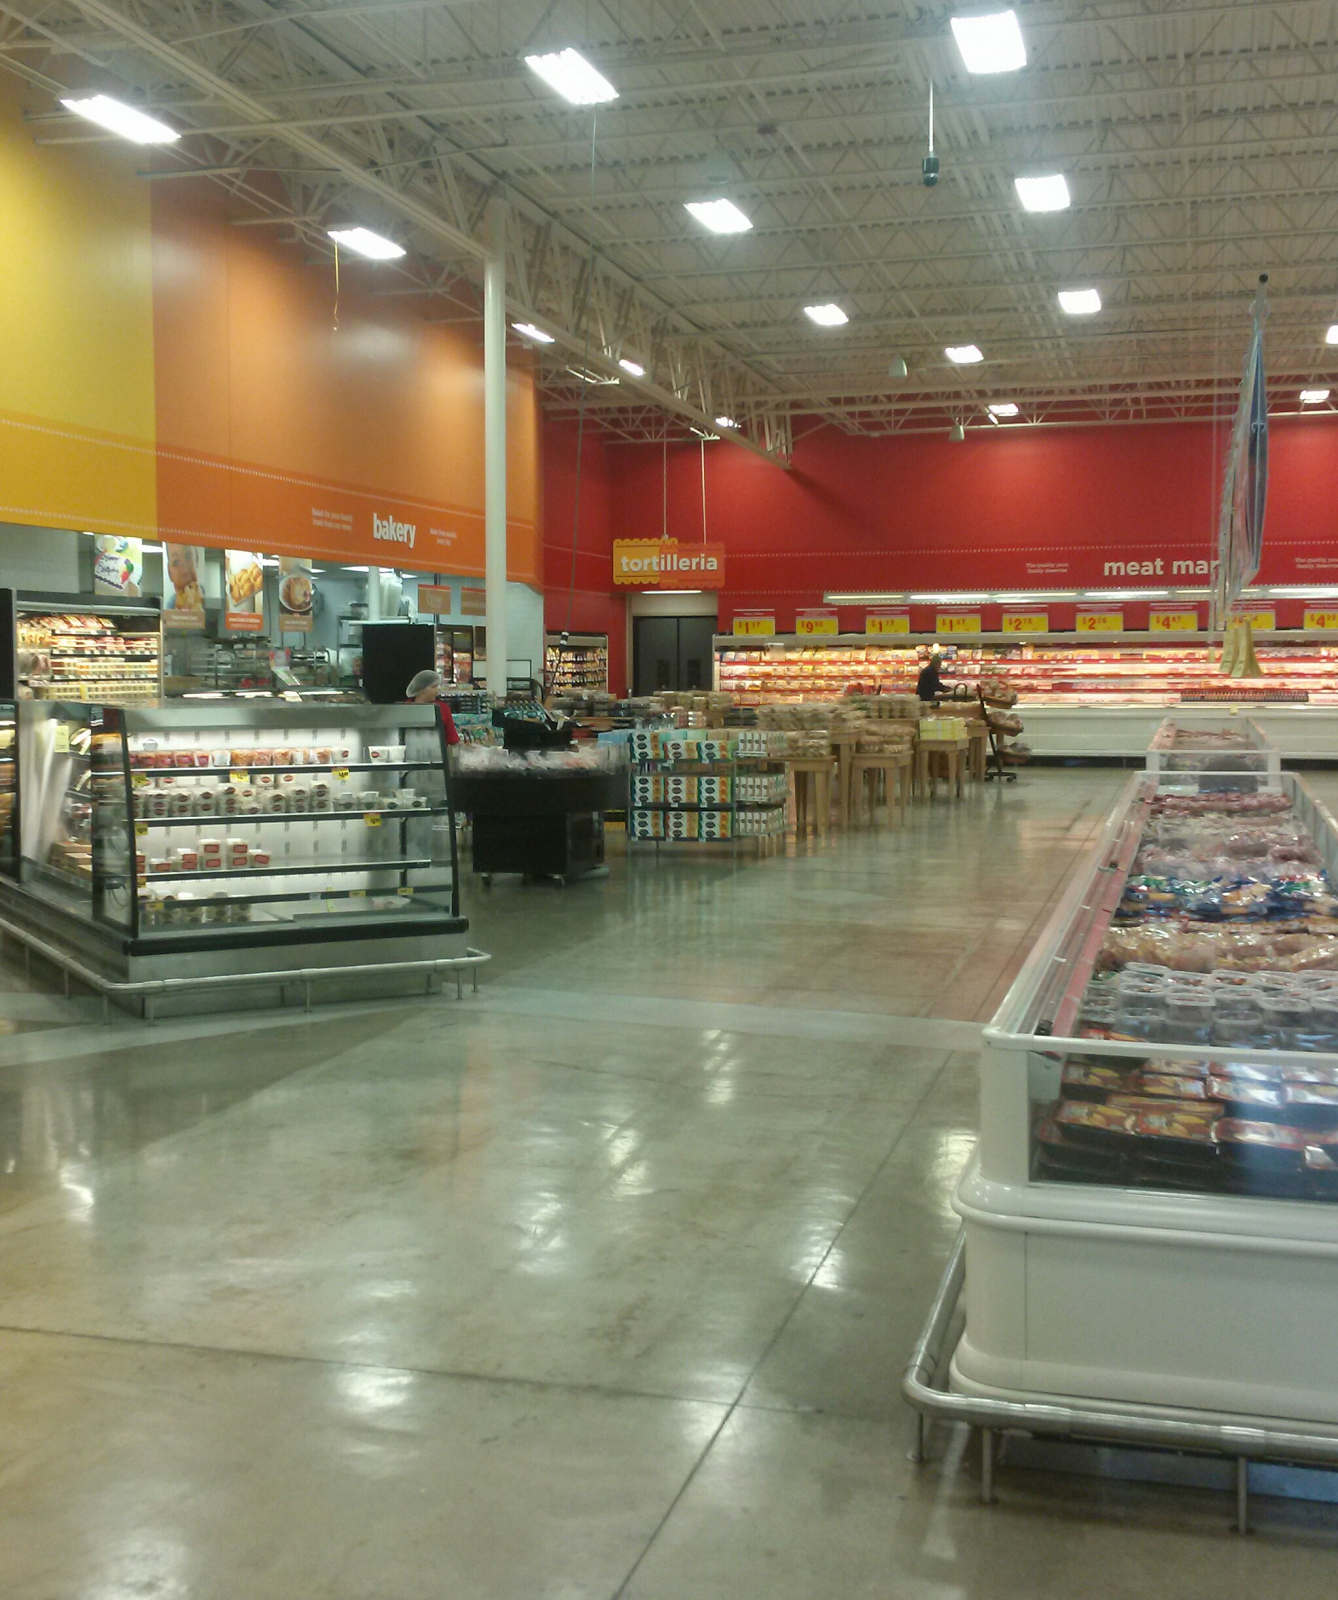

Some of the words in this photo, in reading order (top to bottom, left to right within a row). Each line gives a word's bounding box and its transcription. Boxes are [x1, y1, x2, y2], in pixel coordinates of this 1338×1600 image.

[373, 512, 415, 548] bakery
[621, 553, 718, 572] tortilleria
[1103, 557, 1164, 576] meat
[1172, 558, 1220, 576] mar
